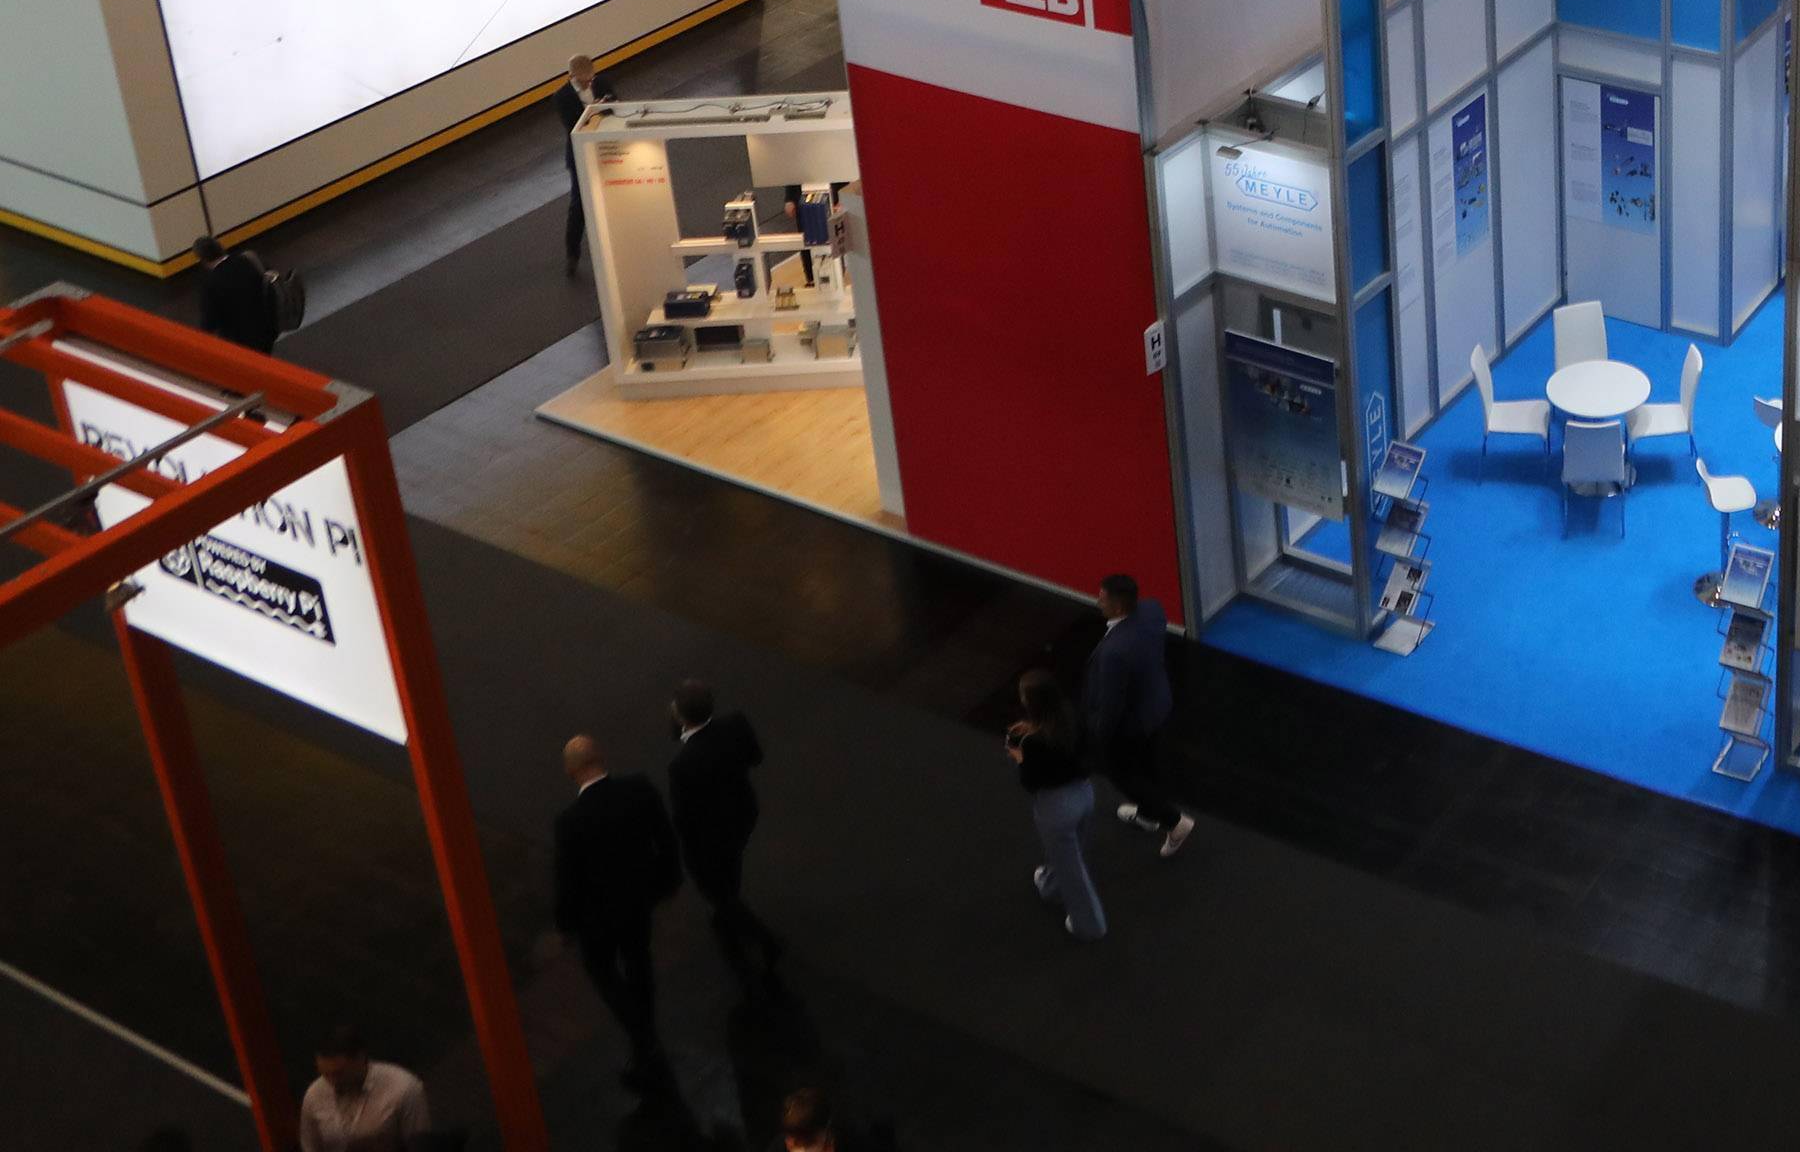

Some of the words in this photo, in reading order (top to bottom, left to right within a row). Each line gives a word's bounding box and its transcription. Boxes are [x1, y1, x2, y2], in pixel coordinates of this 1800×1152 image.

[1245, 179, 1308, 206] MEYLE
[834, 220, 845, 237] H
[1151, 333, 1161, 351] H
